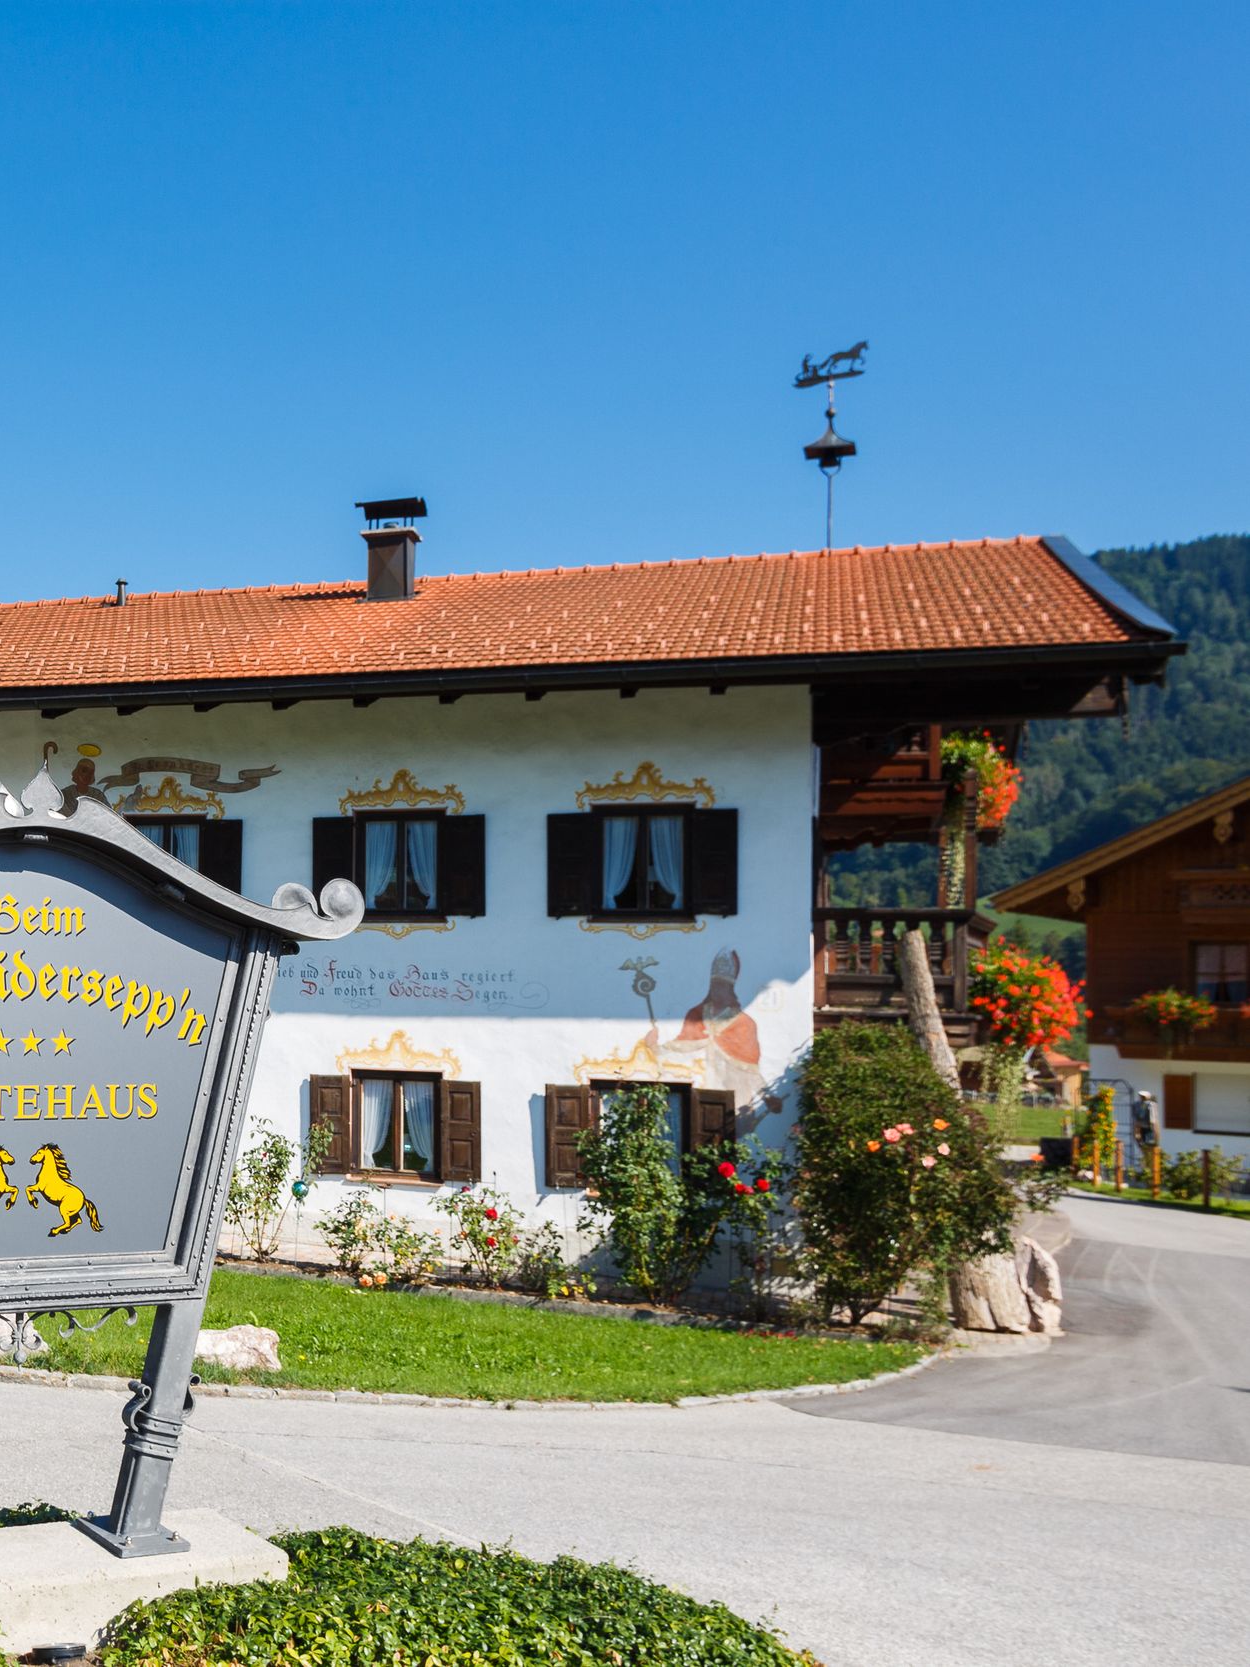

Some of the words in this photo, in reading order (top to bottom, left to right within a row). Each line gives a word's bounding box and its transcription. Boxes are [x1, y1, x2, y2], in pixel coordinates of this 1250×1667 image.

[277, 964, 295, 978] ieb
[300, 963, 319, 979] und
[369, 967, 396, 980] das
[300, 979, 325, 996] Da
[334, 984, 375, 998] wohnt
